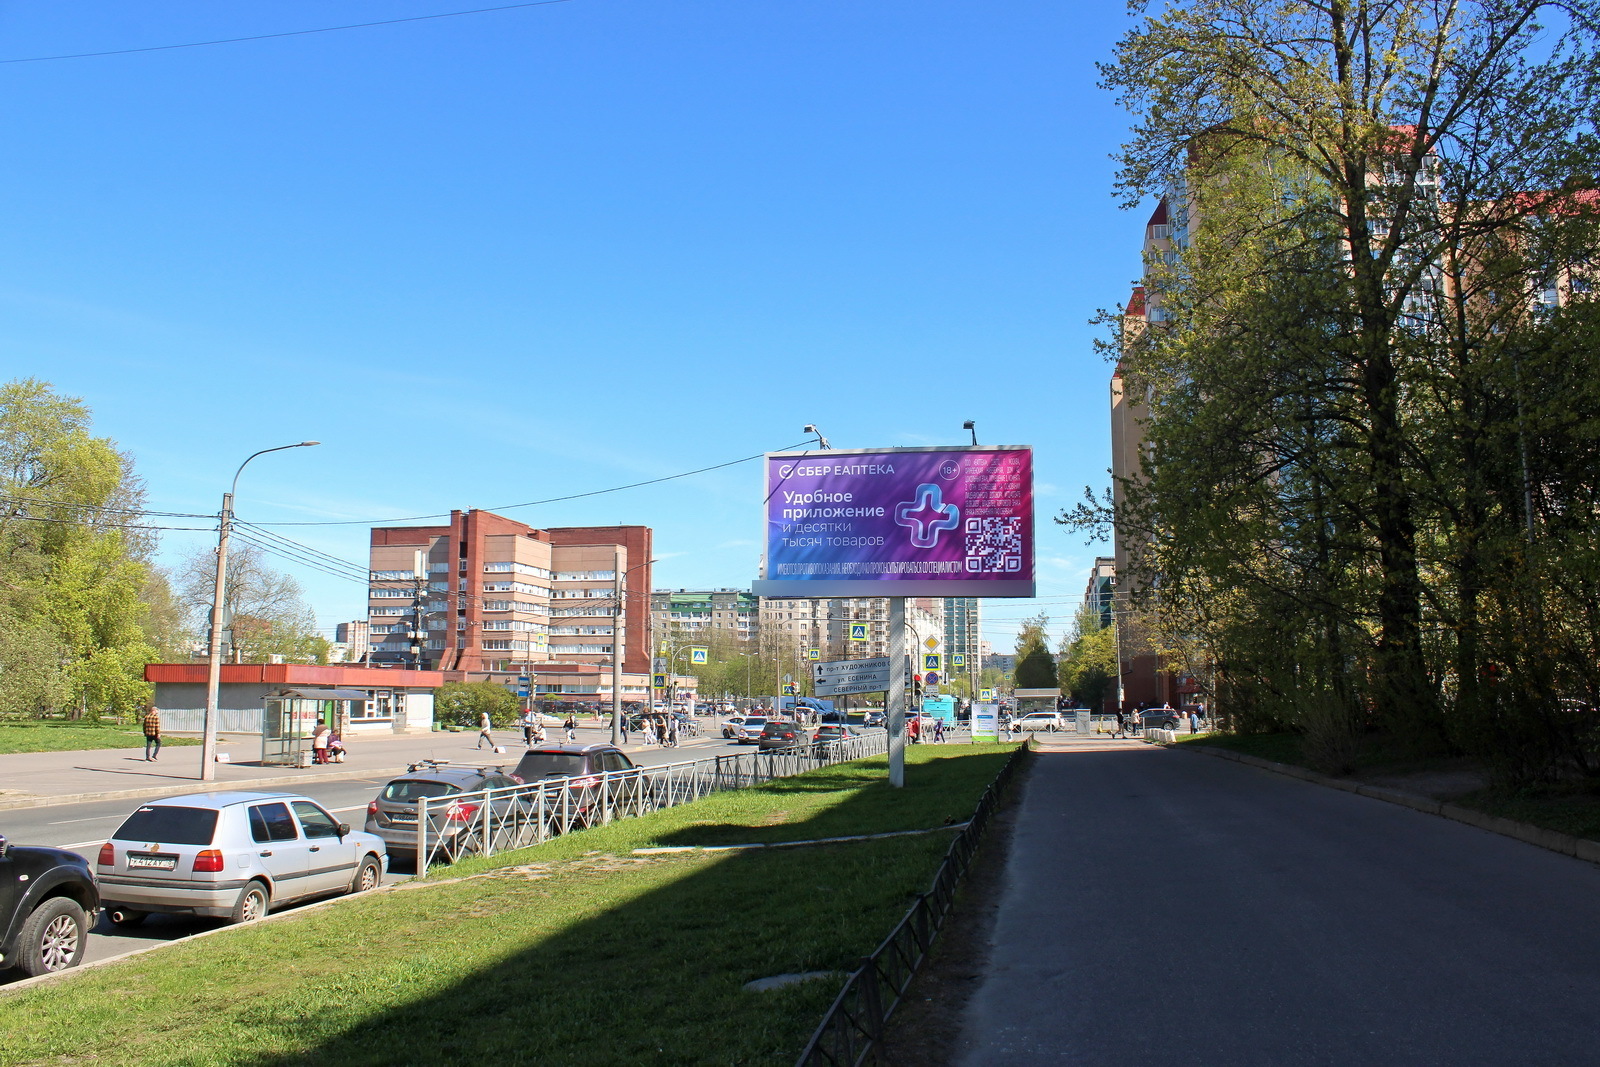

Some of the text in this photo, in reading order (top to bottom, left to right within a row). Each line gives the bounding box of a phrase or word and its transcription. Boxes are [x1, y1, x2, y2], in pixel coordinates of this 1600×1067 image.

[797, 464, 895, 477] СБЕР ЕАПТЕКА
[942, 465, 958, 475] 18+
[783, 489, 853, 506] Удобное
[783, 506, 885, 521] приложение
[782, 521, 852, 534] и десятки
[782, 534, 885, 549] тысяч товаров
[841, 661, 886, 671] ХУДОЖНИКОВ
[847, 674, 877, 682] ЕСЕНИНА
[833, 684, 868, 693] СЕВЕРНЫЙ
